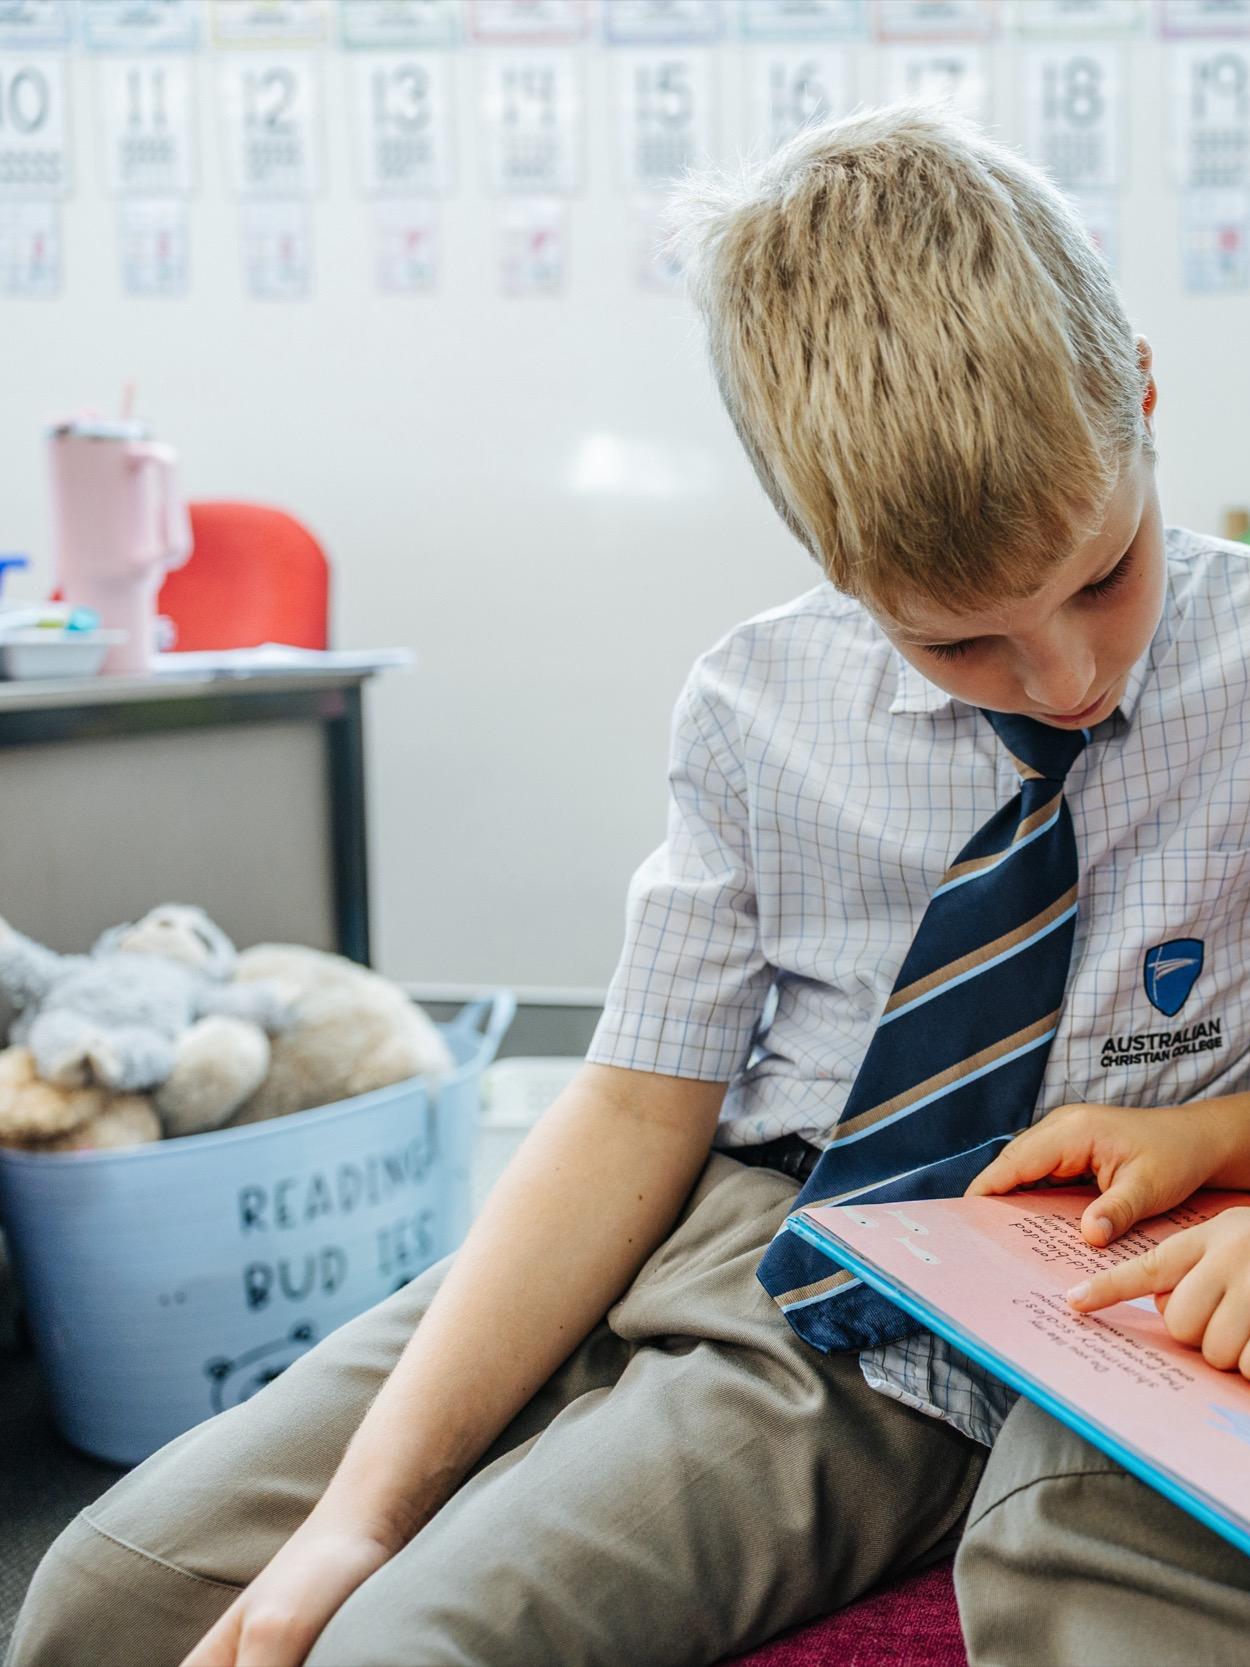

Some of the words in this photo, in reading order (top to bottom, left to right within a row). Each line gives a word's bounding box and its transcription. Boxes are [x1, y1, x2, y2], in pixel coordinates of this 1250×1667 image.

[0, 65, 51, 135] 0
[126, 66, 169, 132] 11
[243, 66, 298, 134] 12
[371, 63, 431, 131] 13
[501, 64, 557, 128] 14
[635, 60, 695, 130] 15
[1042, 56, 1104, 126] 18
[1191, 53, 1250, 120] 19
[1101, 1018, 1221, 1054] AUSTRALIAN
[1101, 1050, 1170, 1067] CHRISTIAN
[1172, 1036, 1222, 1058] COLLEGE
[239, 1138, 436, 1236] READING
[1023, 1217, 1051, 1235] mean
[1052, 1213, 1066, 1221] or
[1008, 1222, 1097, 1275] old-blooded
[1031, 1246, 1049, 1257] am
[1049, 1235, 1087, 1258] doesn't
[1075, 1241, 1107, 1258] blood
[1108, 1247, 1130, 1261] wim
[1087, 1258, 1109, 1271] this
[1012, 1298, 1076, 1334] scales?
[1030, 1290, 1072, 1317] armour
[1072, 1317, 1095, 1331] like
[1093, 1331, 1112, 1344] me
[1111, 1343, 1160, 1371] protect
[1124, 1338, 1144, 1350] me
[1167, 1367, 1195, 1382] and
